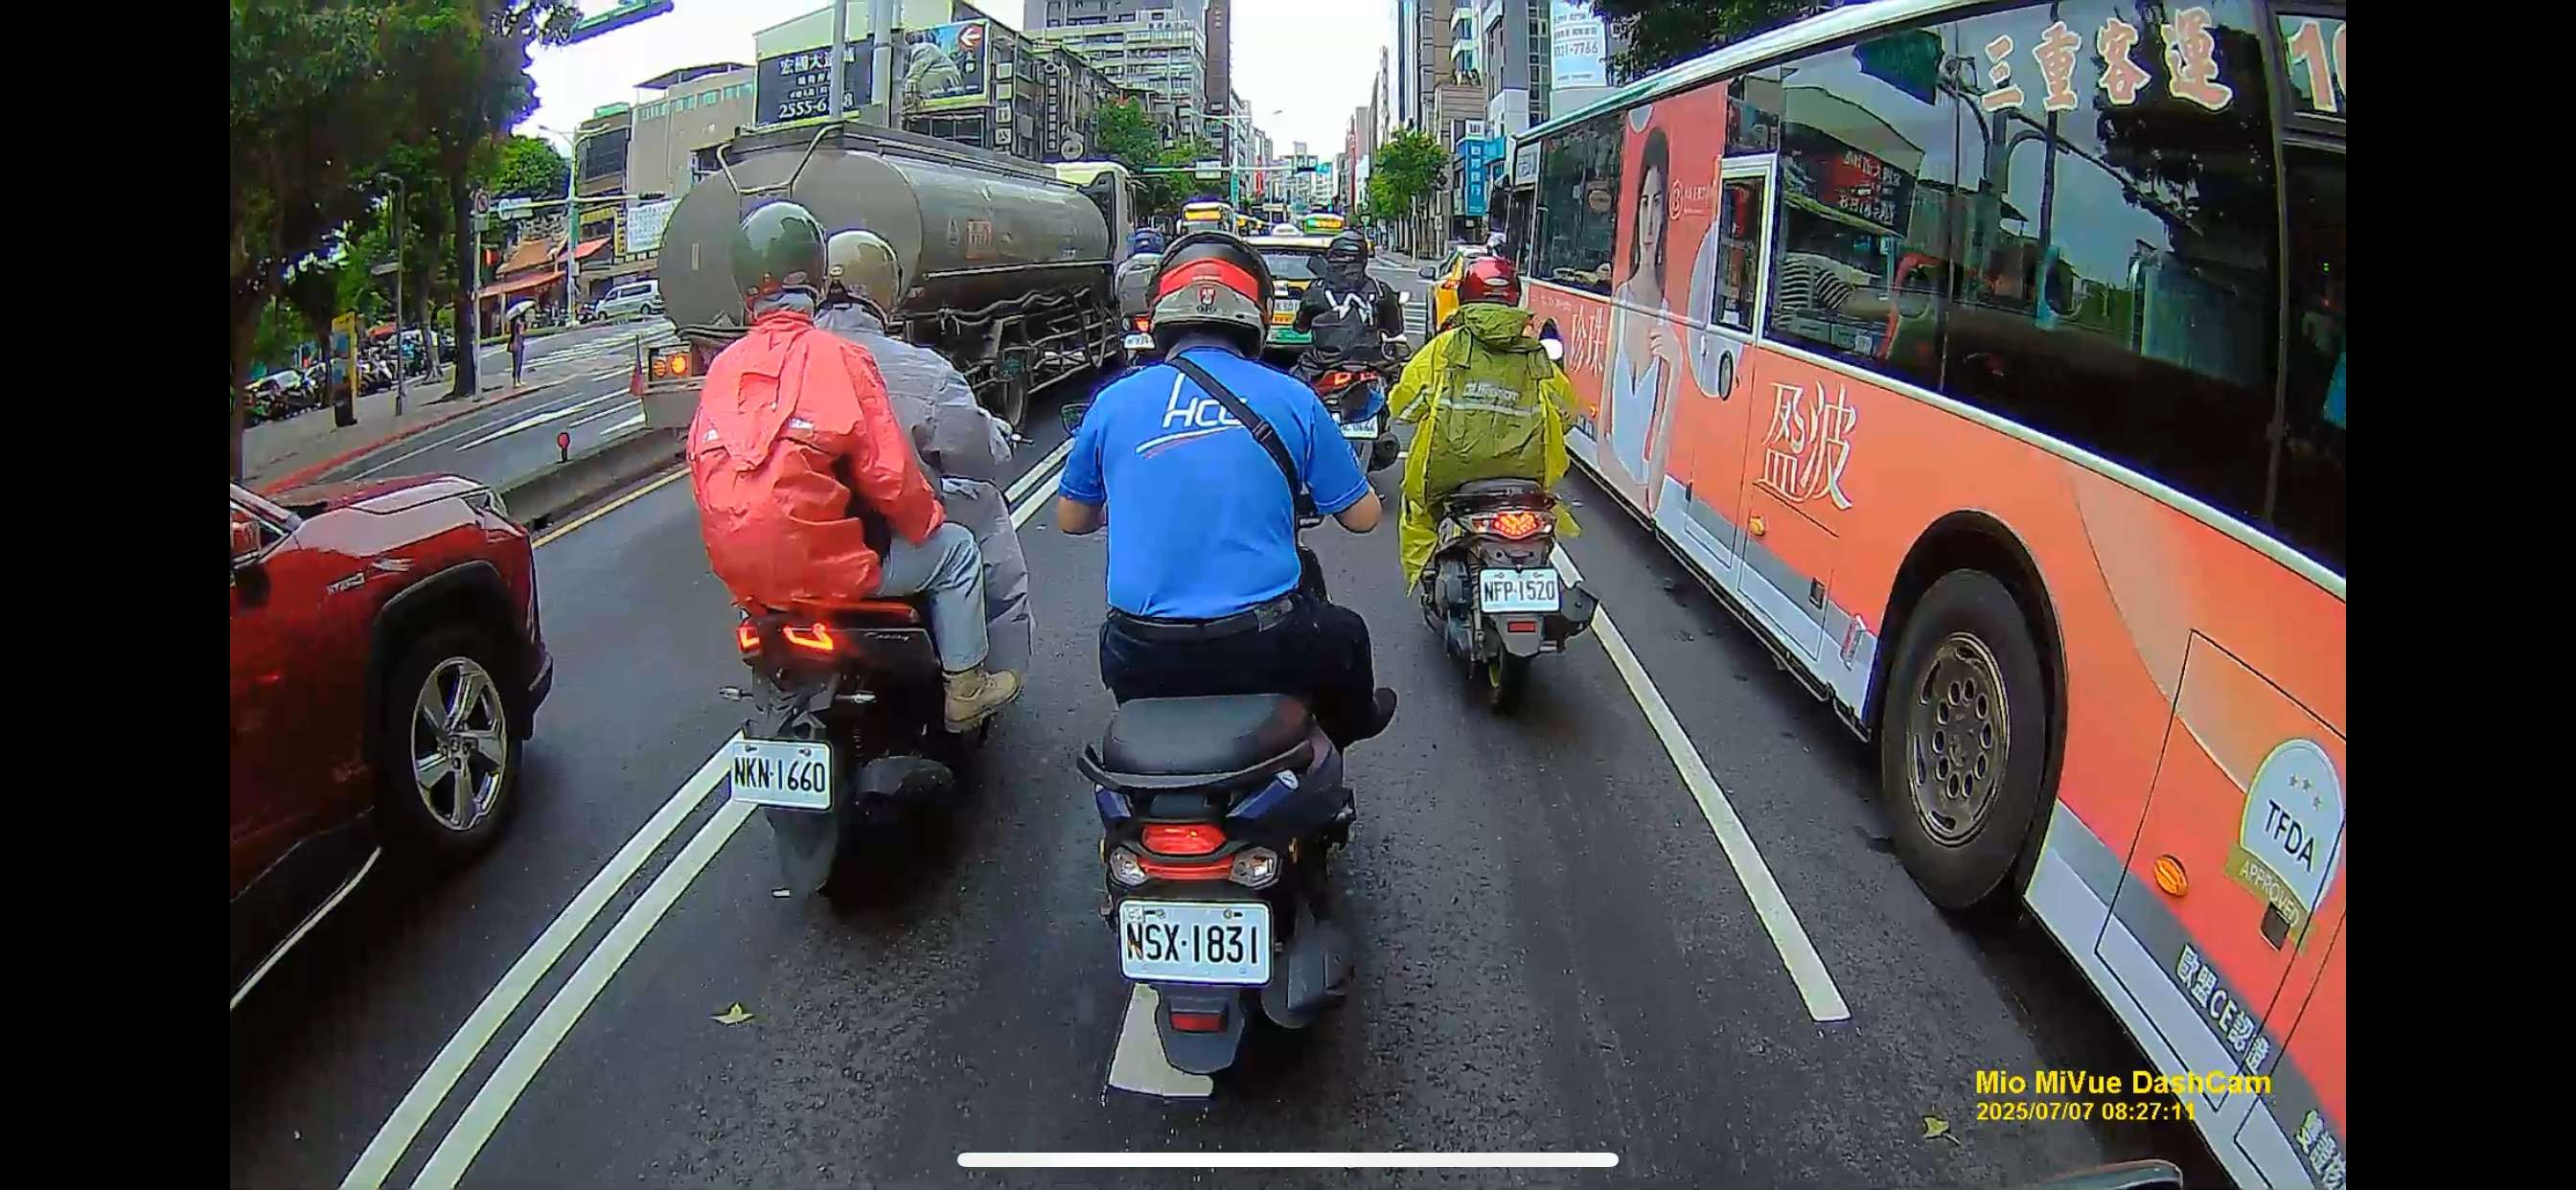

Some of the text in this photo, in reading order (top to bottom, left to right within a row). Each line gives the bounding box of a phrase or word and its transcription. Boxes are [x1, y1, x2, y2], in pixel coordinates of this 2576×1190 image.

[1982, 7, 2233, 113] 三重客運
[1484, 581, 1556, 603] NFP-1520
[734, 756, 827, 793] NKN-1660
[2265, 799, 2314, 874] TFDA
[2240, 861, 2301, 927] APPROVED
[1126, 923, 1258, 965] NSX-1831
